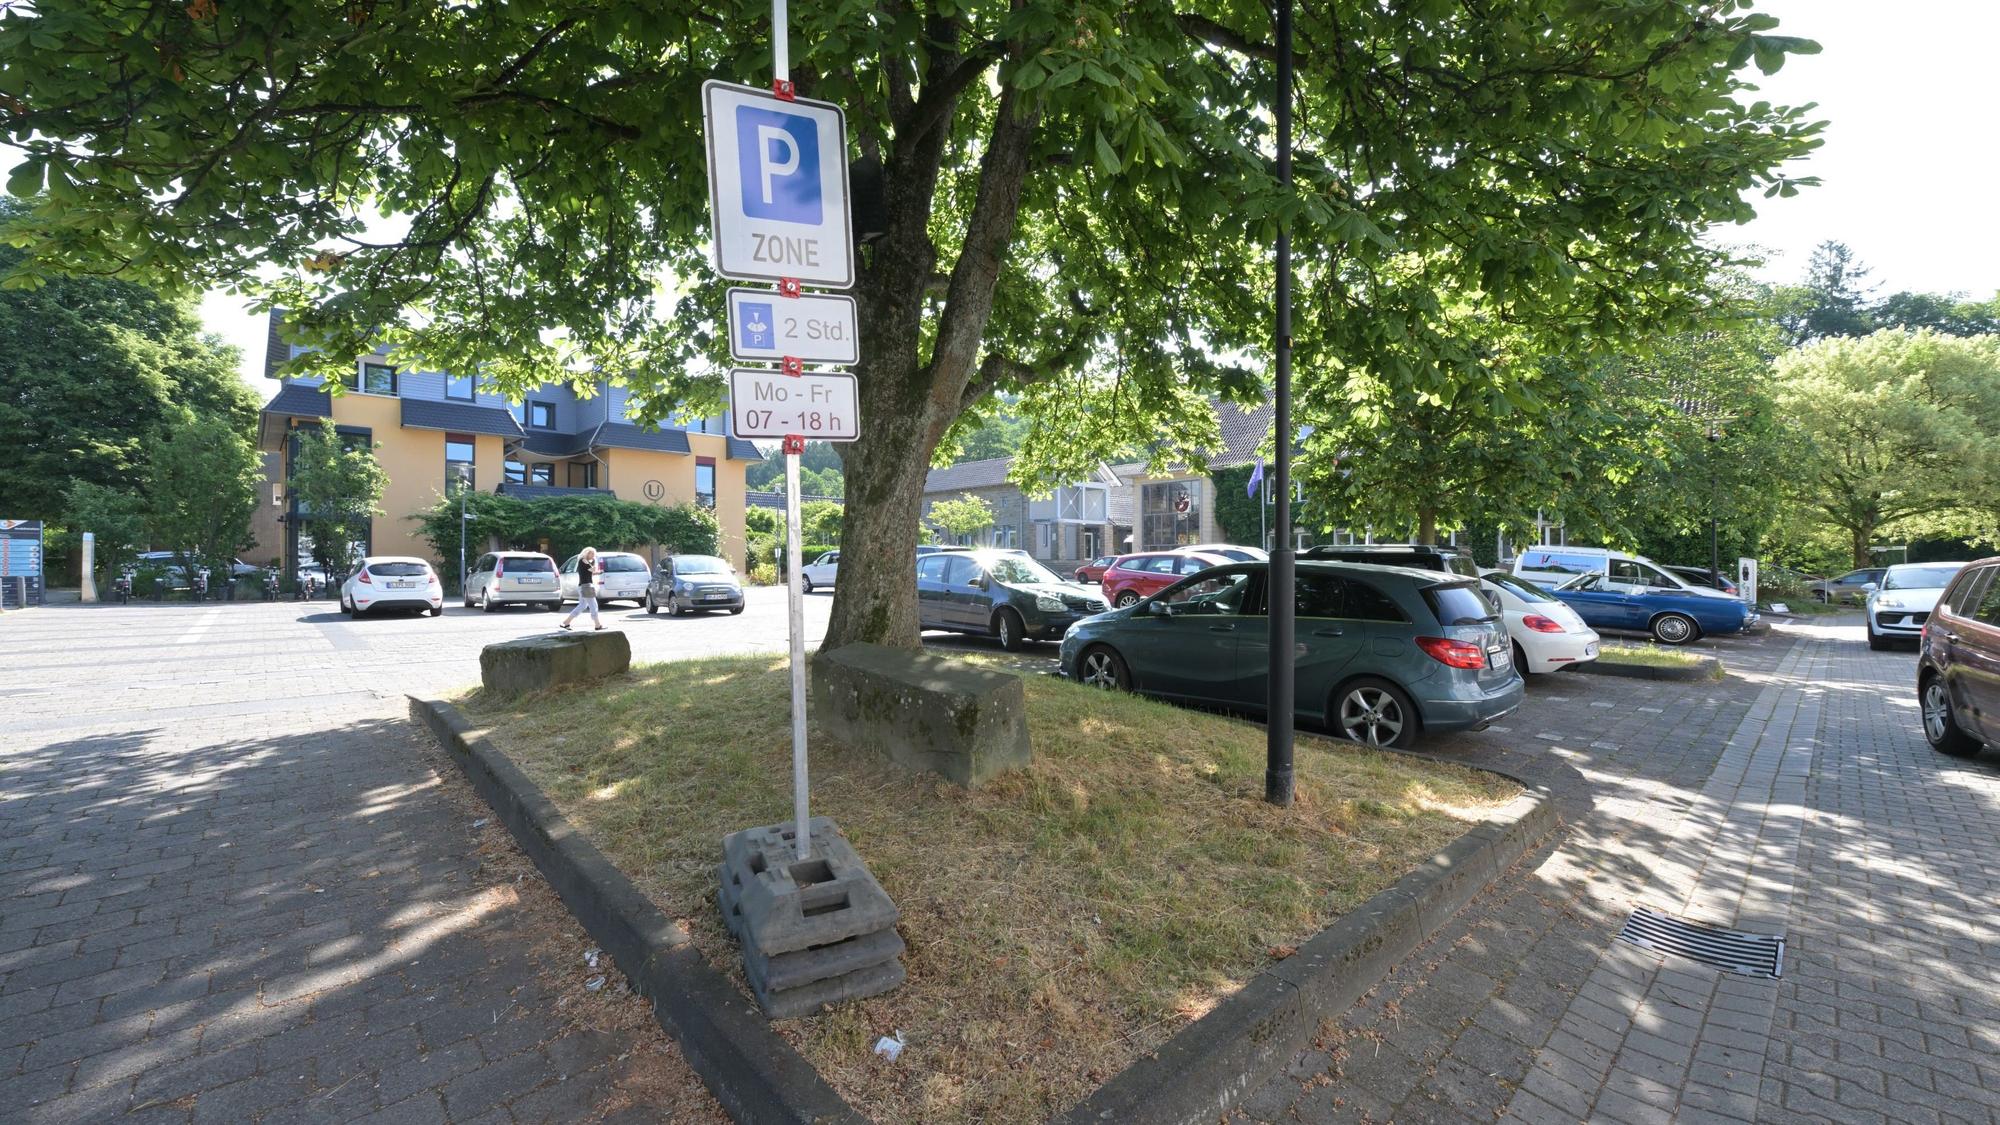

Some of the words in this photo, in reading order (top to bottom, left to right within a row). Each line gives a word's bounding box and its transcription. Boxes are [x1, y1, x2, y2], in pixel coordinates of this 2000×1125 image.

[758, 124, 800, 204] P
[752, 233, 820, 267] ZONE
[753, 334, 762, 345] P
[784, 318, 798, 338] 2
[806, 319, 850, 341] Std.
[754, 381, 788, 402] Mo
[811, 384, 832, 403] Fr
[746, 409, 773, 429] 07
[797, 411, 822, 431] 18
[829, 412, 841, 431] h
